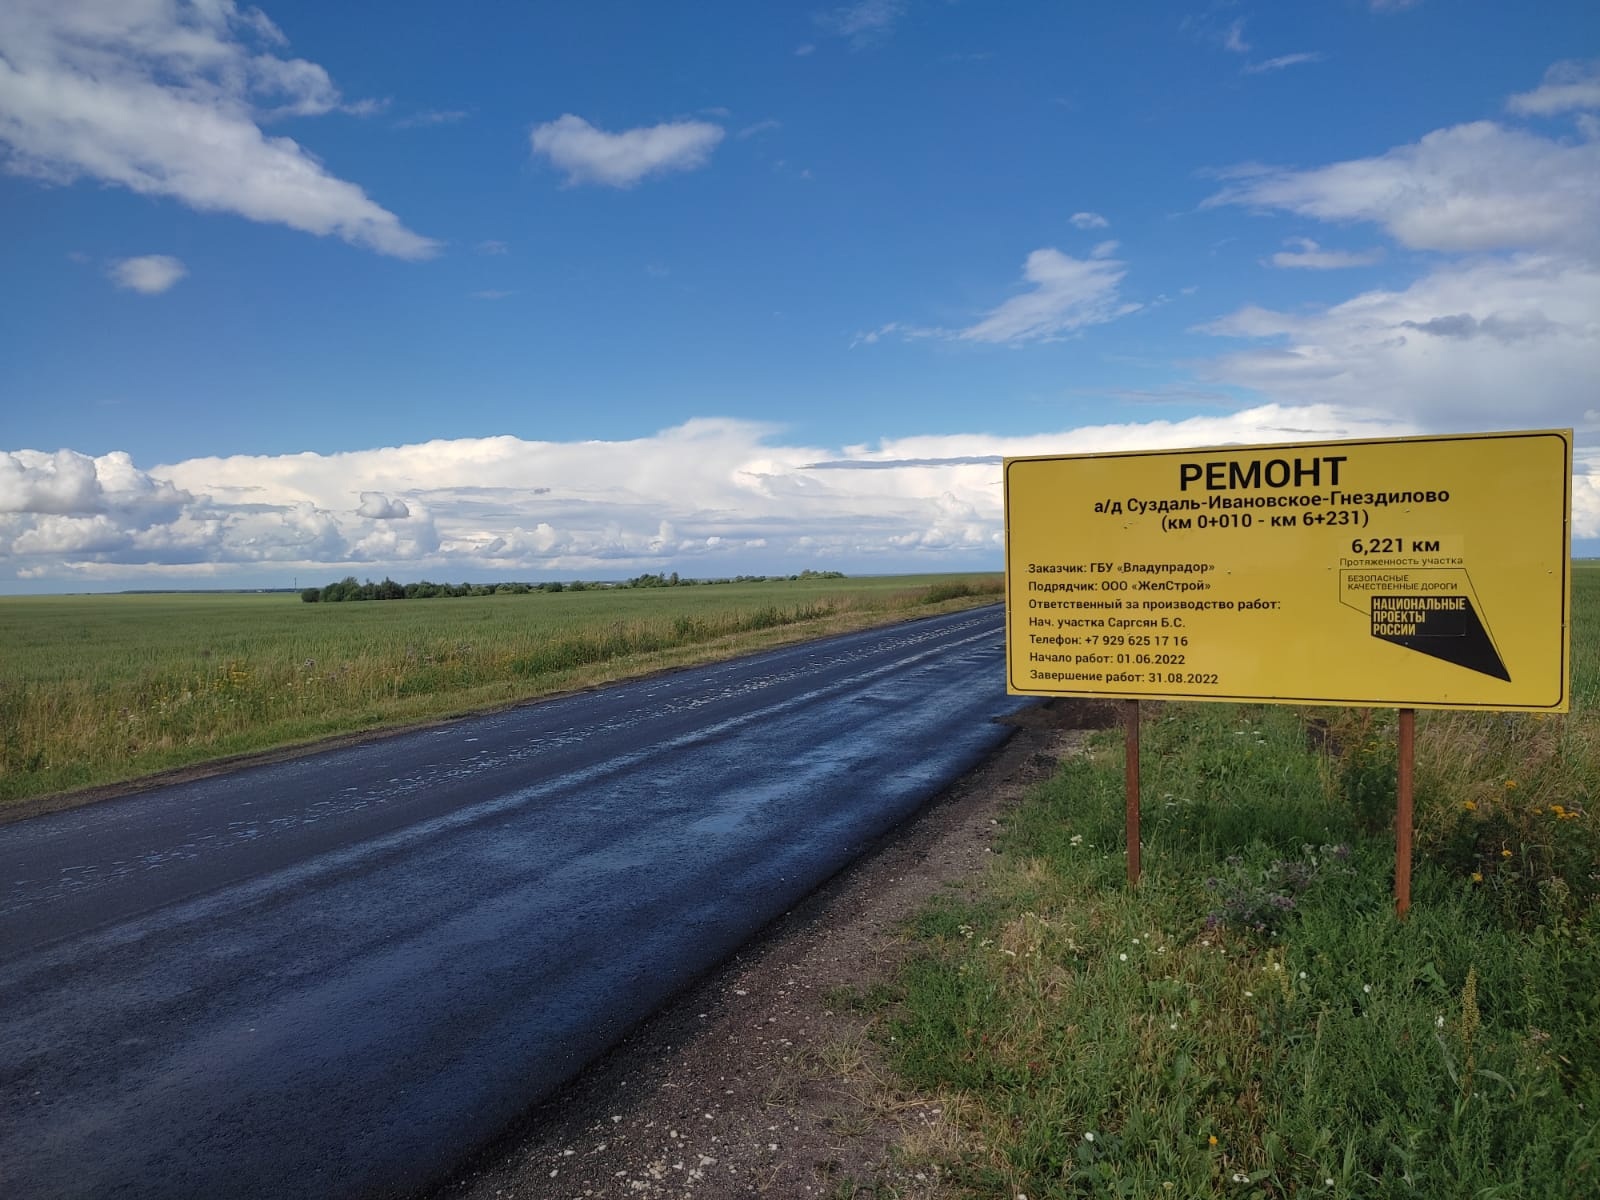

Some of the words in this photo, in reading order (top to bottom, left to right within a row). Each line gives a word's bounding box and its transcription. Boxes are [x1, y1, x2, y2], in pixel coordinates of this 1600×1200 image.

[1180, 456, 1347, 491] РЕМОНТ
[1094, 499, 1123, 515] а/д
[1127, 490, 1450, 515] Суздаль-Ивановское-Гнездилово
[1161, 515, 1192, 532] (км
[1197, 514, 1252, 529] 0+010
[1271, 515, 1296, 527] км
[1303, 510, 1369, 528] 6+231)
[1351, 538, 1403, 555] 6,221
[1412, 540, 1440, 552] км
[1028, 563, 1087, 574] Заказчик:
[1090, 562, 1113, 573] ГБУ
[1117, 562, 1215, 575] «Владупрадор»
[1339, 557, 1419, 568] Протяженность
[1421, 557, 1463, 567] участка
[1347, 574, 1409, 582] БЕЗОПАСНЫЕ
[1028, 581, 1098, 593] Подрядчик:
[1101, 580, 1128, 591] ООО
[1132, 579, 1211, 593] «ЖелСтрой»
[1347, 582, 1419, 591] КАЧЕСТВЕННЫЕ
[1421, 582, 1458, 591] ДОРОГИ
[1028, 598, 1122, 609] Ответственный
[1126, 601, 1139, 609] за
[1142, 601, 1234, 611] производство
[1237, 598, 1281, 611] работ:
[1373, 598, 1466, 611] НАЦИОНАЛЬНЫЕ
[1029, 617, 1054, 627] Нач.
[1057, 618, 1104, 630] участка
[1108, 618, 1158, 629] Саргсян
[1161, 618, 1186, 628] Б.С.
[1373, 611, 1426, 623] ПРОЕКТЫ
[1373, 623, 1416, 635] РОССИИ
[1030, 634, 1082, 647] Телефон:
[1084, 635, 1099, 645] +7
[1102, 635, 1125, 646] 929
[1128, 635, 1151, 646] 625
[1155, 636, 1170, 646] 17
[1173, 636, 1189, 647] 16
[1030, 652, 1072, 663] Начало
[1075, 653, 1114, 665] работ:
[1117, 653, 1186, 665] 01.06.2022
[1030, 670, 1103, 681] Завершение
[1106, 671, 1145, 684] работ:
[1148, 672, 1219, 685] 31.08.2022
